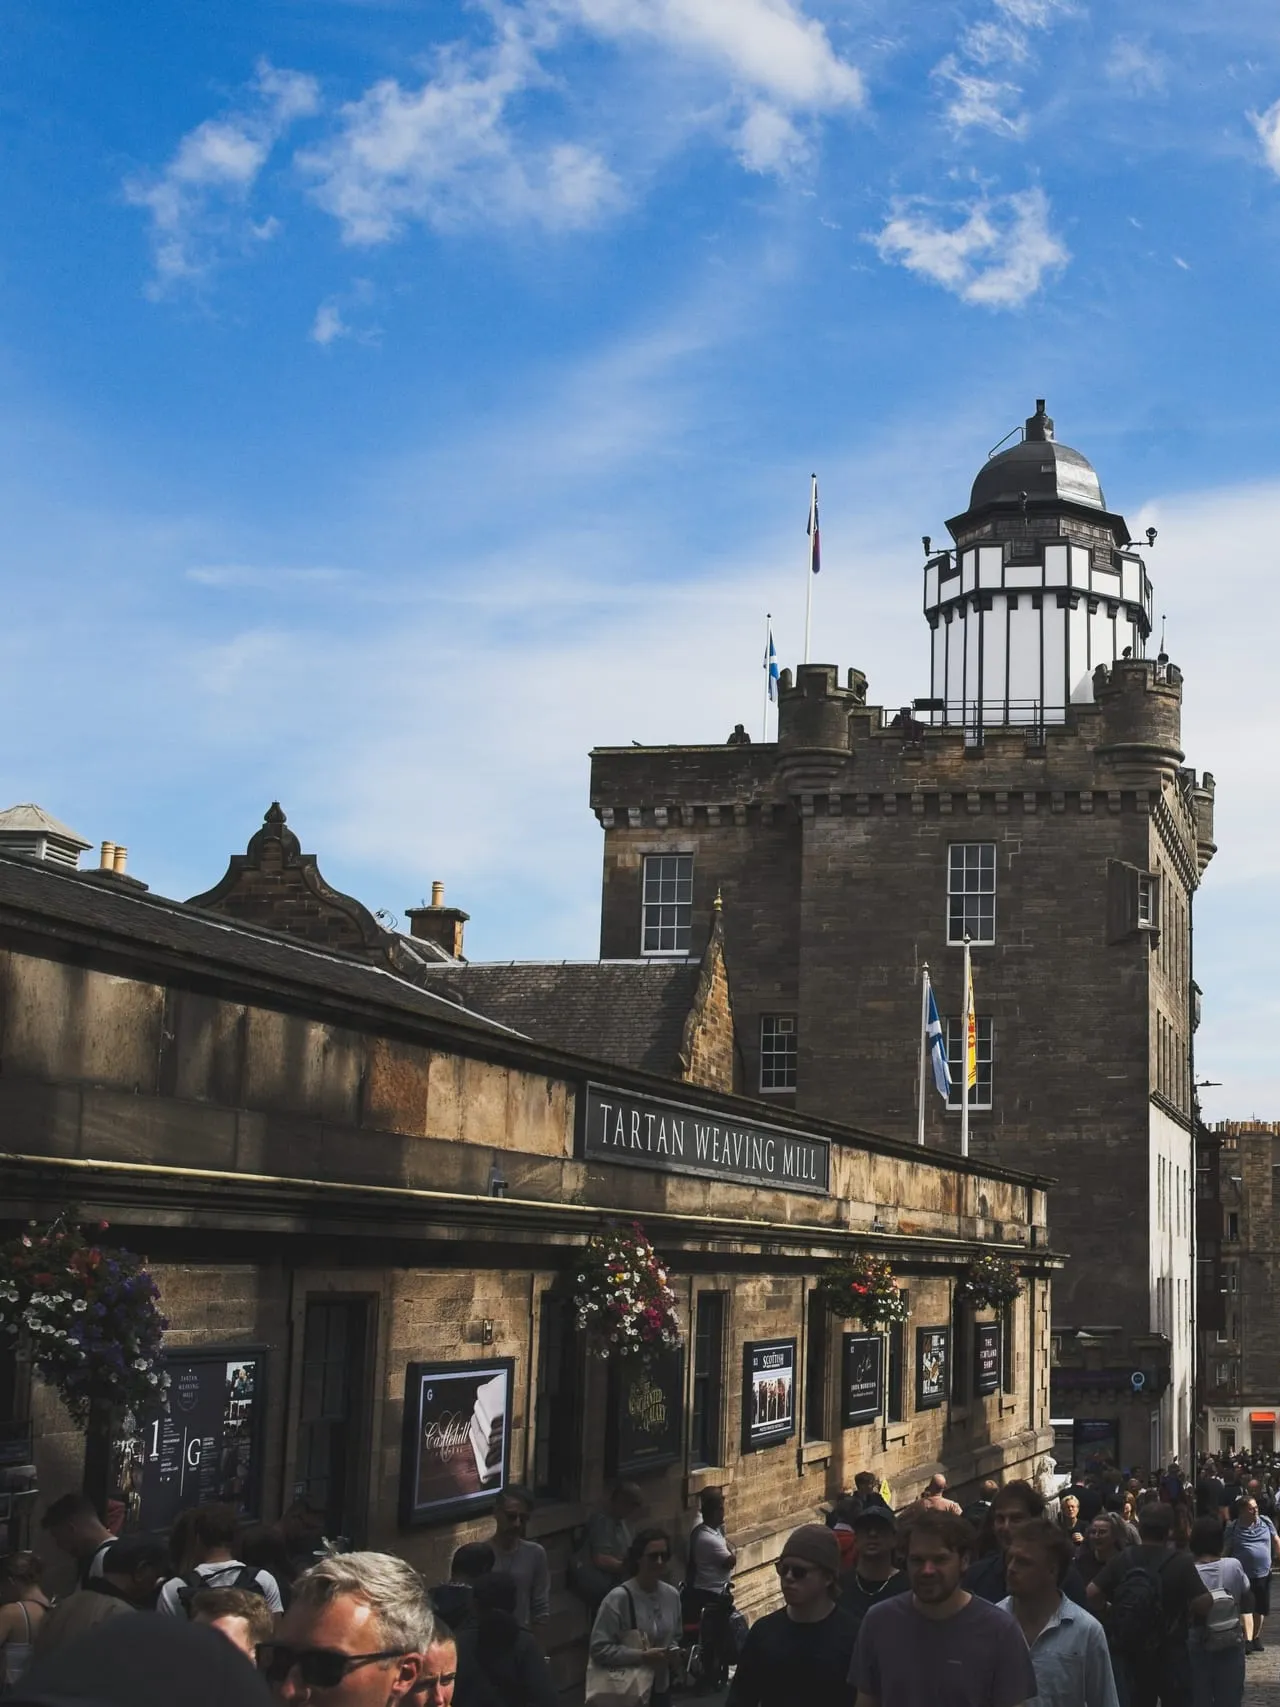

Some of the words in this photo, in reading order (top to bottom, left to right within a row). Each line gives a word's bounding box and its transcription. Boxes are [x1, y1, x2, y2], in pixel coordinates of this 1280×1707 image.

[600, 1103, 684, 1156] TARTAN
[694, 1123, 775, 1172] WEAVING
[782, 1144, 817, 1180] MILL
[762, 1353, 785, 1369] SCOTTISH
[426, 1388, 434, 1401] G
[149, 1419, 160, 1457] 1
[187, 1438, 202, 1466] G
